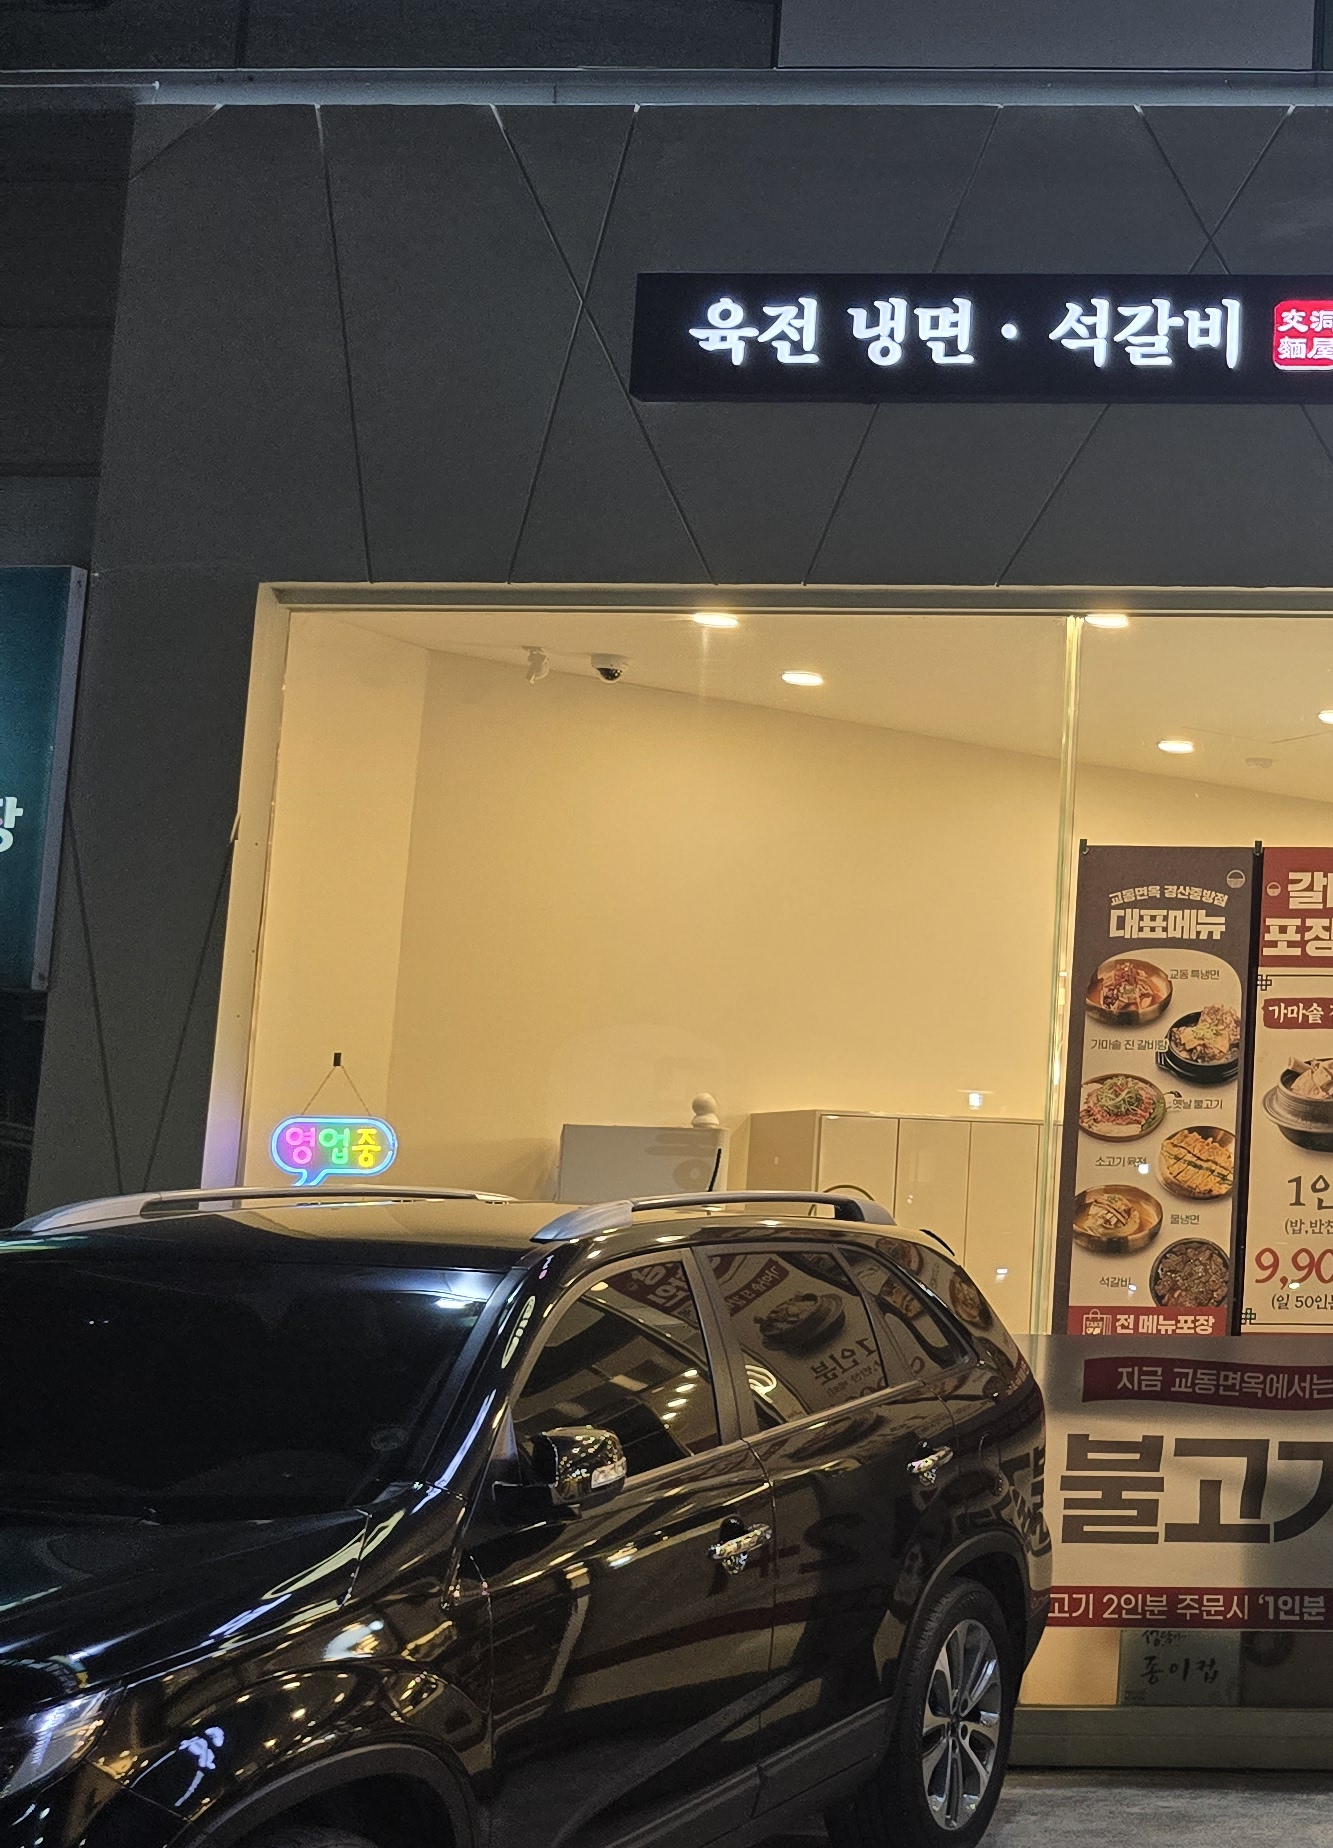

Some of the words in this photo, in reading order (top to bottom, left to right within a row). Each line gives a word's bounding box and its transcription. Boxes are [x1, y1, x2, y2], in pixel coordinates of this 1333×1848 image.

[688, 296, 816, 368] 육전
[848, 296, 974, 368] 냉면
[1048, 297, 1243, 370] 석갈비
[1110, 886, 1161, 906] 교동면옥
[1163, 885, 1228, 908] 경산중방점
[1109, 908, 1226, 940] 대표메뉴
[1170, 969, 1189, 980] 교동
[1191, 969, 1220, 981] 특냉면
[1124, 1039, 1135, 1050] 진
[1137, 1039, 1168, 1051] 갈비탕
[1172, 1099, 1192, 1110] 옛날
[1194, 1099, 1223, 1110] 불고기
[285, 1126, 381, 1168] 영업중
[1095, 1156, 1126, 1167] 소고기
[1170, 1214, 1200, 1225] 물냉면
[1100, 1276, 1132, 1288] 석갈비
[1271, 1294, 1290, 1312] (일
[1116, 1314, 1135, 1334] 전
[1138, 1314, 1216, 1335] 메뉴포장
[1117, 1367, 1164, 1393] 지금
[1102, 1594, 1168, 1620] 2인분
[1176, 1594, 1246, 1621] 주문시
[1140, 1655, 1219, 1685] 종이컵
